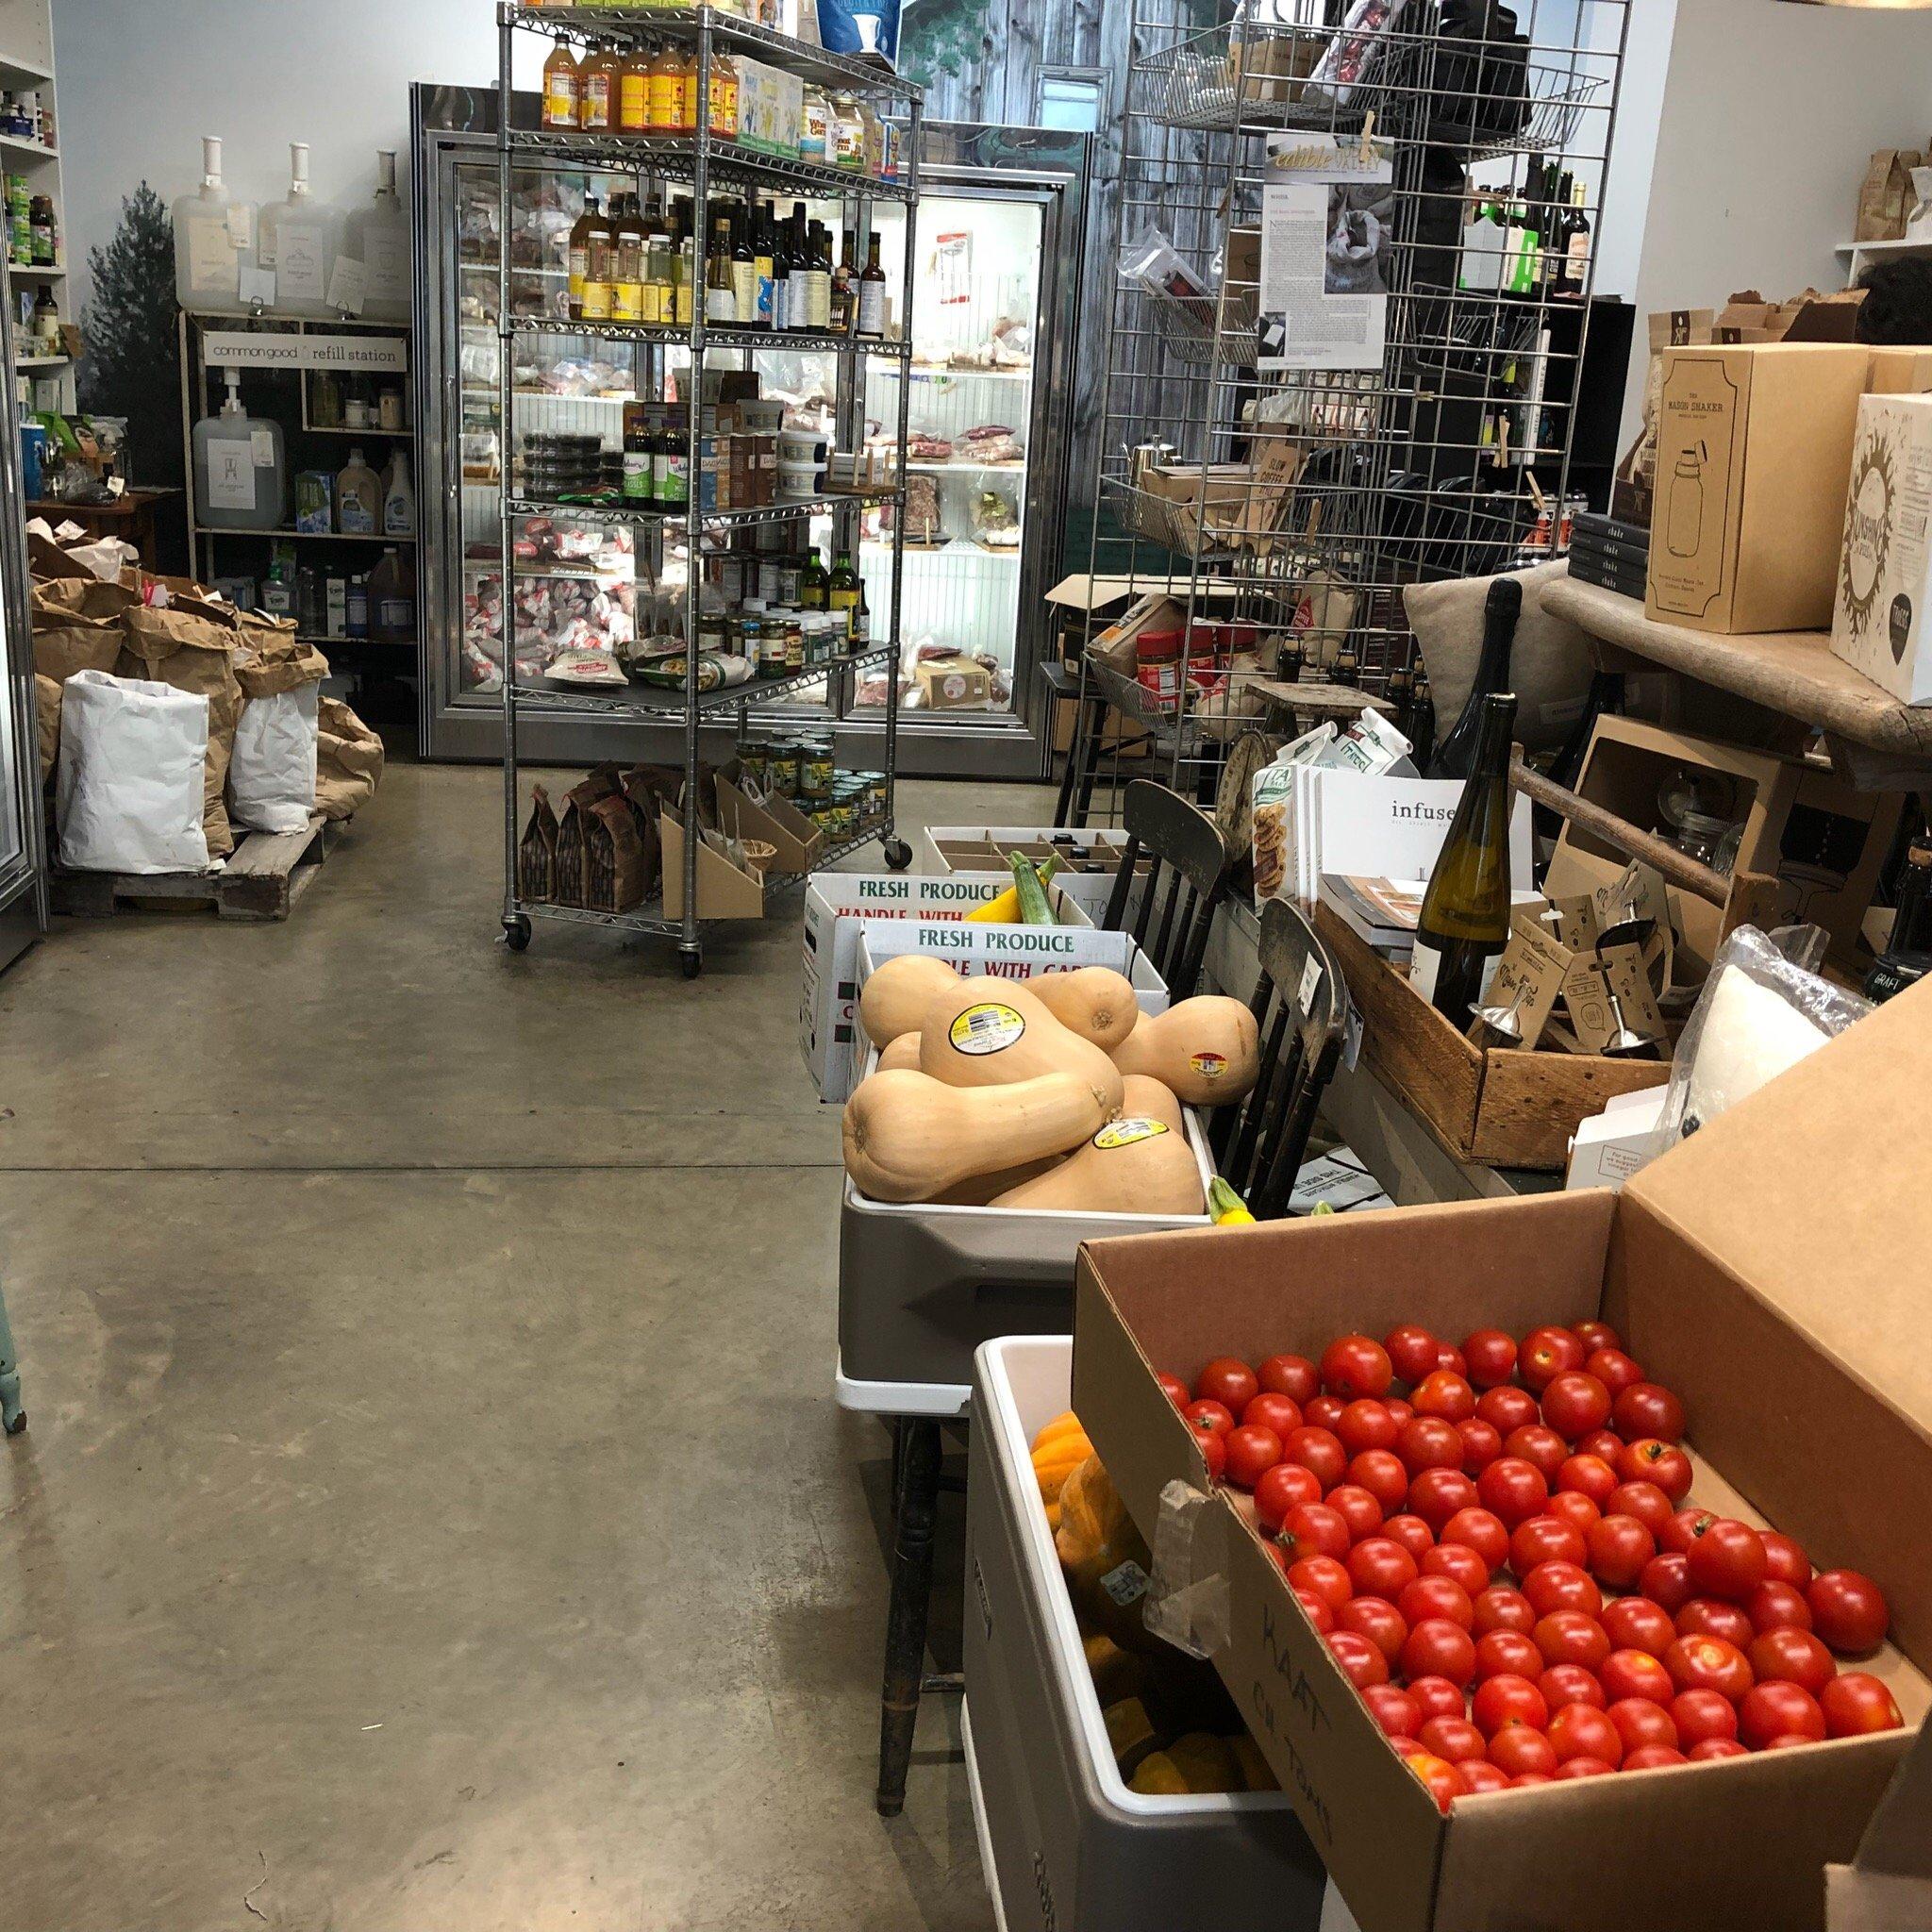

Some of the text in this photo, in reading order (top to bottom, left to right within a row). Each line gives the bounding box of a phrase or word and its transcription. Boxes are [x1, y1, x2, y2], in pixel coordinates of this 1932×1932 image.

[312, 345, 345, 360] refill
[348, 349, 396, 362] station
[1668, 401, 1724, 412] MASON SHAKER
[1607, 526, 1624, 539] shake
[1391, 800, 1456, 821] infuse
[858, 880, 1000, 901] FRESH PRODUCE
[919, 929, 1074, 953] FRESH PRODUCE
[984, 960, 1032, 979] WITH
[1874, 973, 1899, 991] GRAFT
